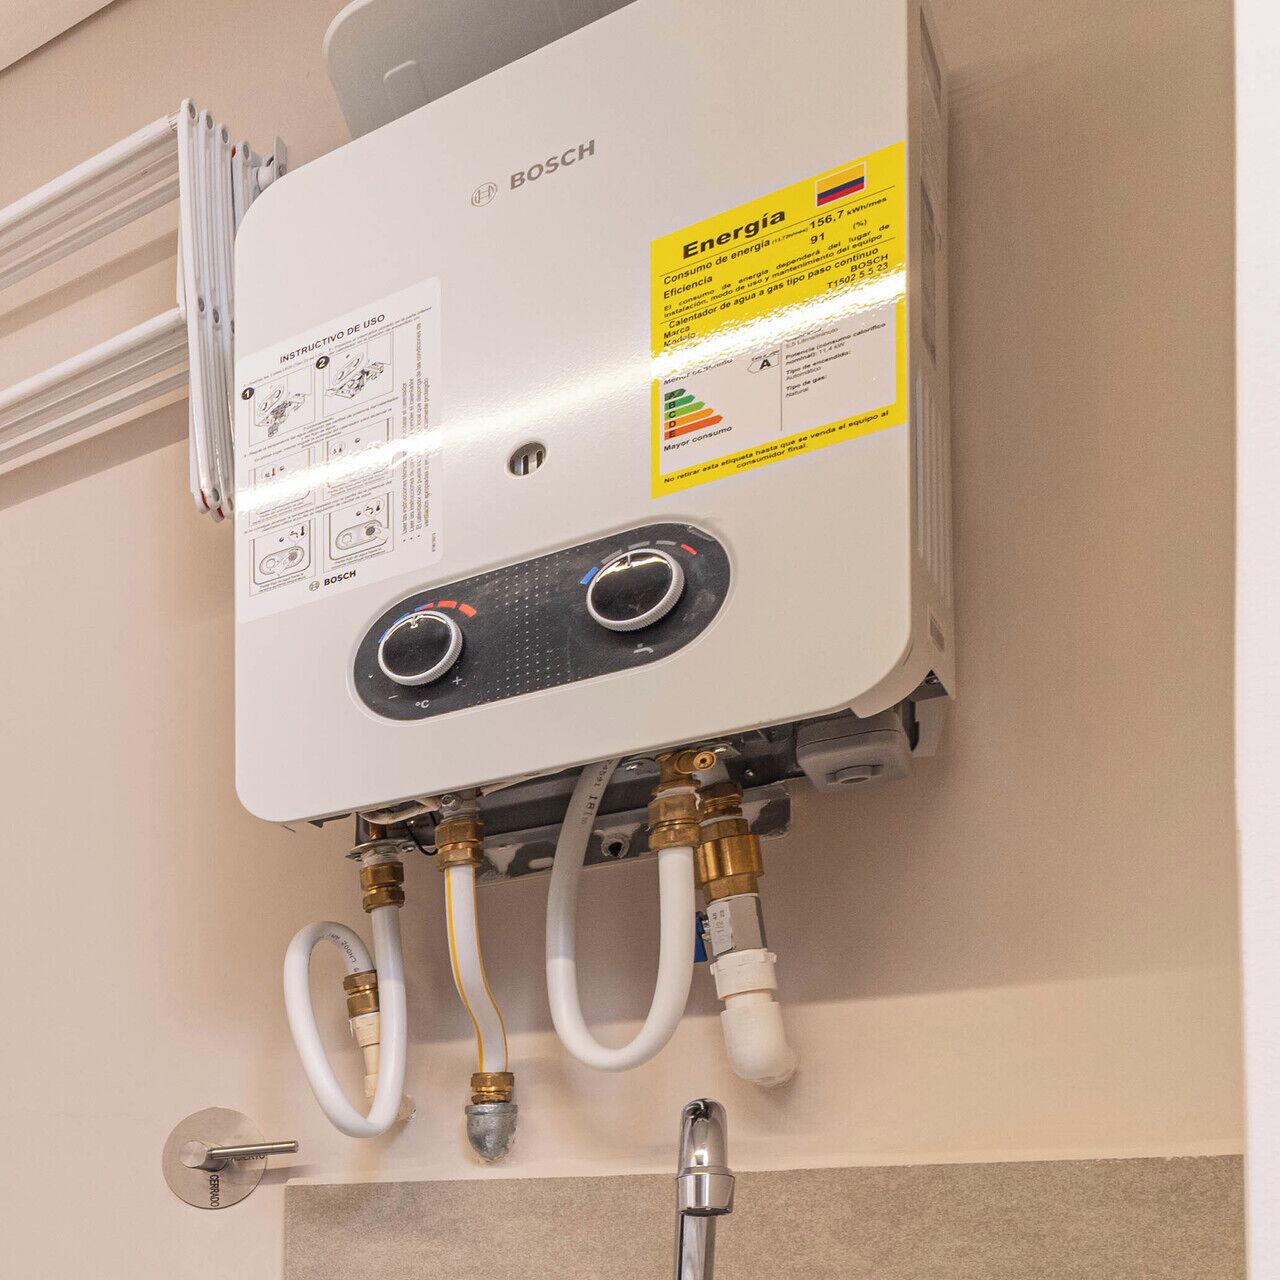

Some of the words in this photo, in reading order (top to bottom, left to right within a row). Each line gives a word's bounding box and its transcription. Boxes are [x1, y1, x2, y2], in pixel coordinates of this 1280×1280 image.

[510, 139, 596, 190] BOSCH
[664, 262, 712, 285] Consumo
[715, 256, 728, 265] de
[731, 240, 770, 259] energía
[810, 209, 843, 229] 156,7
[847, 197, 887, 215] kWh/mes
[683, 211, 785, 259] Energía
[664, 276, 712, 299] Eficiencia
[810, 232, 824, 244] 91
[853, 219, 867, 230] (%)
[678, 290, 714, 306] consumo
[738, 269, 768, 284] energía
[776, 249, 820, 269] dependerá
[828, 241, 840, 250] del
[848, 231, 871, 243] lugar
[710, 290, 732, 301] modo
[747, 279, 762, 287] uso
[772, 252, 834, 278] mantenimiento
[836, 245, 849, 254] del
[852, 235, 882, 249] equipo
[669, 306, 717, 328] Calentador
[720, 302, 730, 310] de
[733, 293, 756, 305] agua
[767, 283, 783, 294] gas
[786, 275, 805, 286] tipo
[808, 265, 831, 280] paso
[834, 248, 878, 268] continuo
[827, 273, 856, 288] T1502
[877, 262, 888, 271] 23
[664, 326, 690, 339] Marca
[851, 253, 888, 272] BOSCH
[280, 331, 344, 363] INSTRUCTIVO
[347, 324, 360, 335] DE
[364, 314, 385, 328] USO
[785, 347, 813, 360] Potencia
[816, 335, 851, 350] (consumo
[759, 359, 771, 370] A
[785, 366, 821, 381] Automático
[668, 401, 676, 409] B
[786, 387, 808, 397] Natural
[664, 440, 689, 451] Mayor
[692, 426, 732, 442] consumo
[668, 429, 676, 438] E
[669, 420, 676, 429] D
[677, 469, 700, 479] retirar
[721, 453, 753, 466] etiqueta
[755, 445, 777, 455] hasta
[780, 440, 795, 448] que
[810, 427, 835, 438] venda
[848, 415, 878, 427] equipo
[736, 450, 785, 468] consumidor
[787, 443, 806, 452] final.
[324, 570, 356, 586] BOSCH
[209, 1174, 220, 1207] CERRADO
